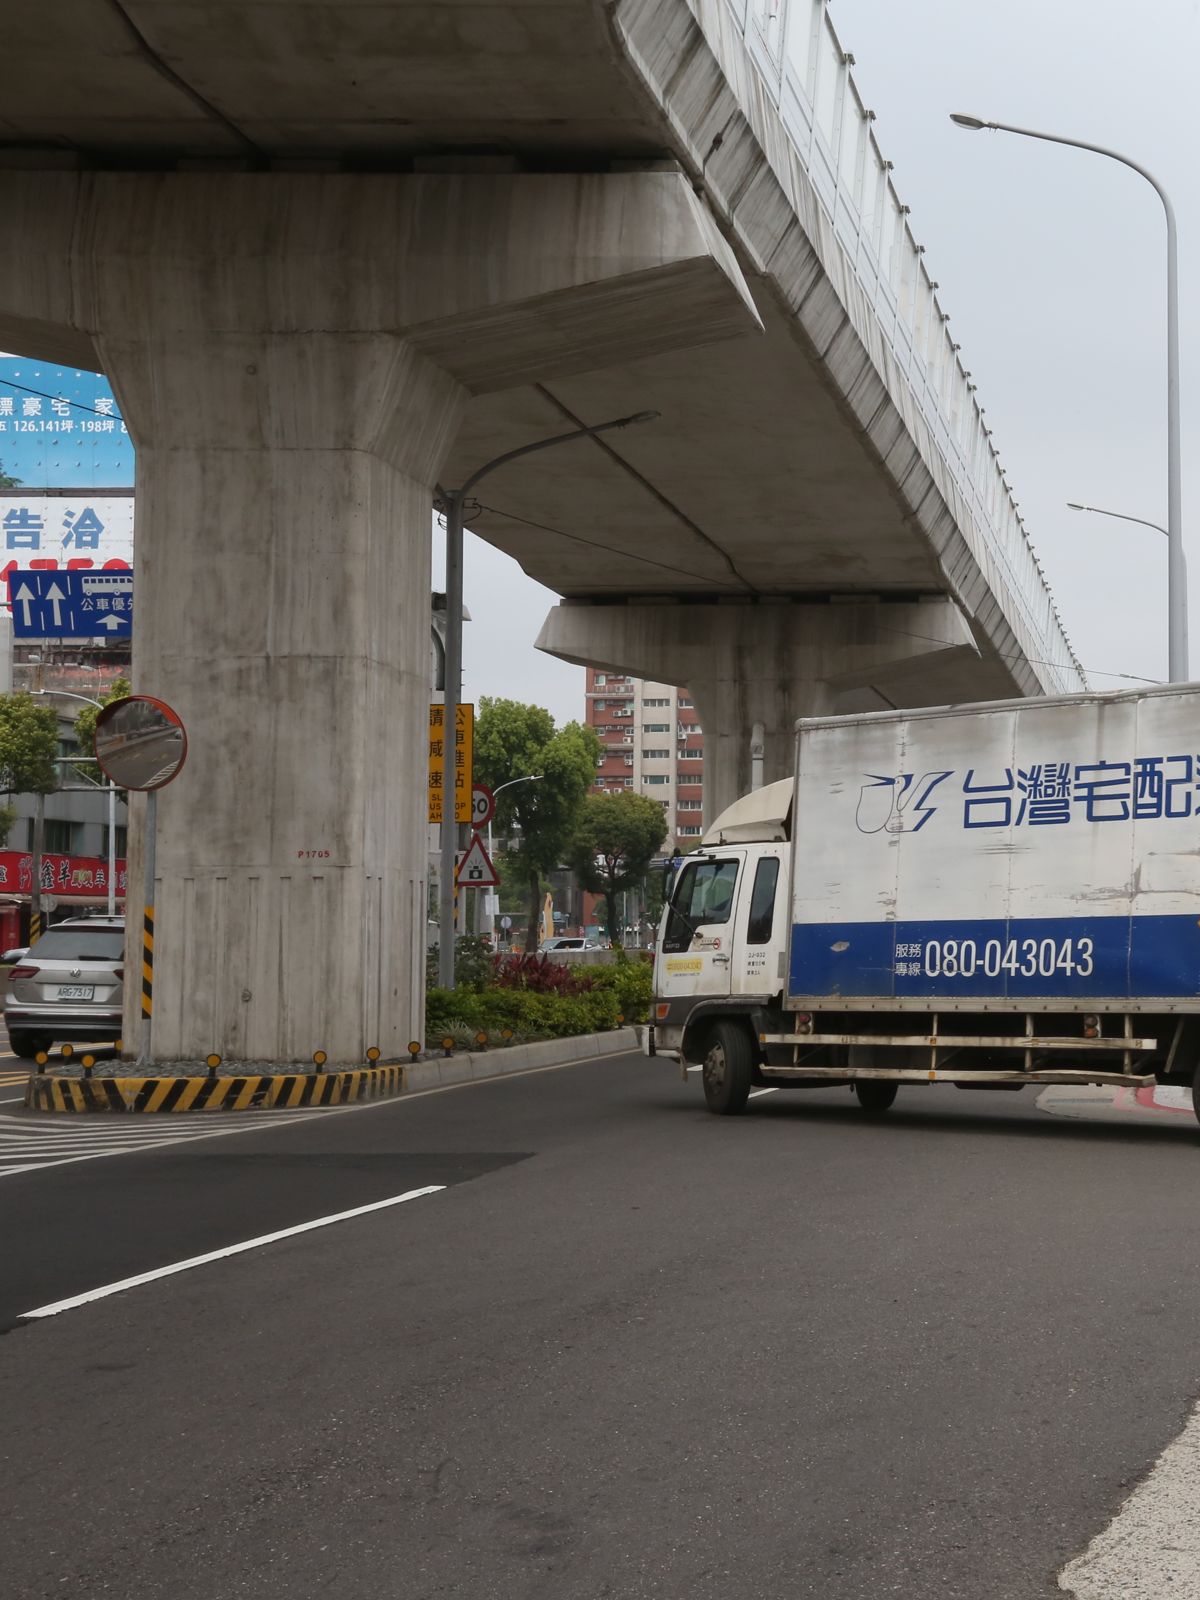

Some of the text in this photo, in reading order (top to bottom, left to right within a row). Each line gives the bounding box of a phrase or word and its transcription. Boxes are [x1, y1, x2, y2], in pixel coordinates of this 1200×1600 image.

[298, 850, 330, 858] P1705
[895, 943, 922, 958] 服務
[925, 938, 1094, 977] 080-043043
[895, 962, 922, 976] 專線
